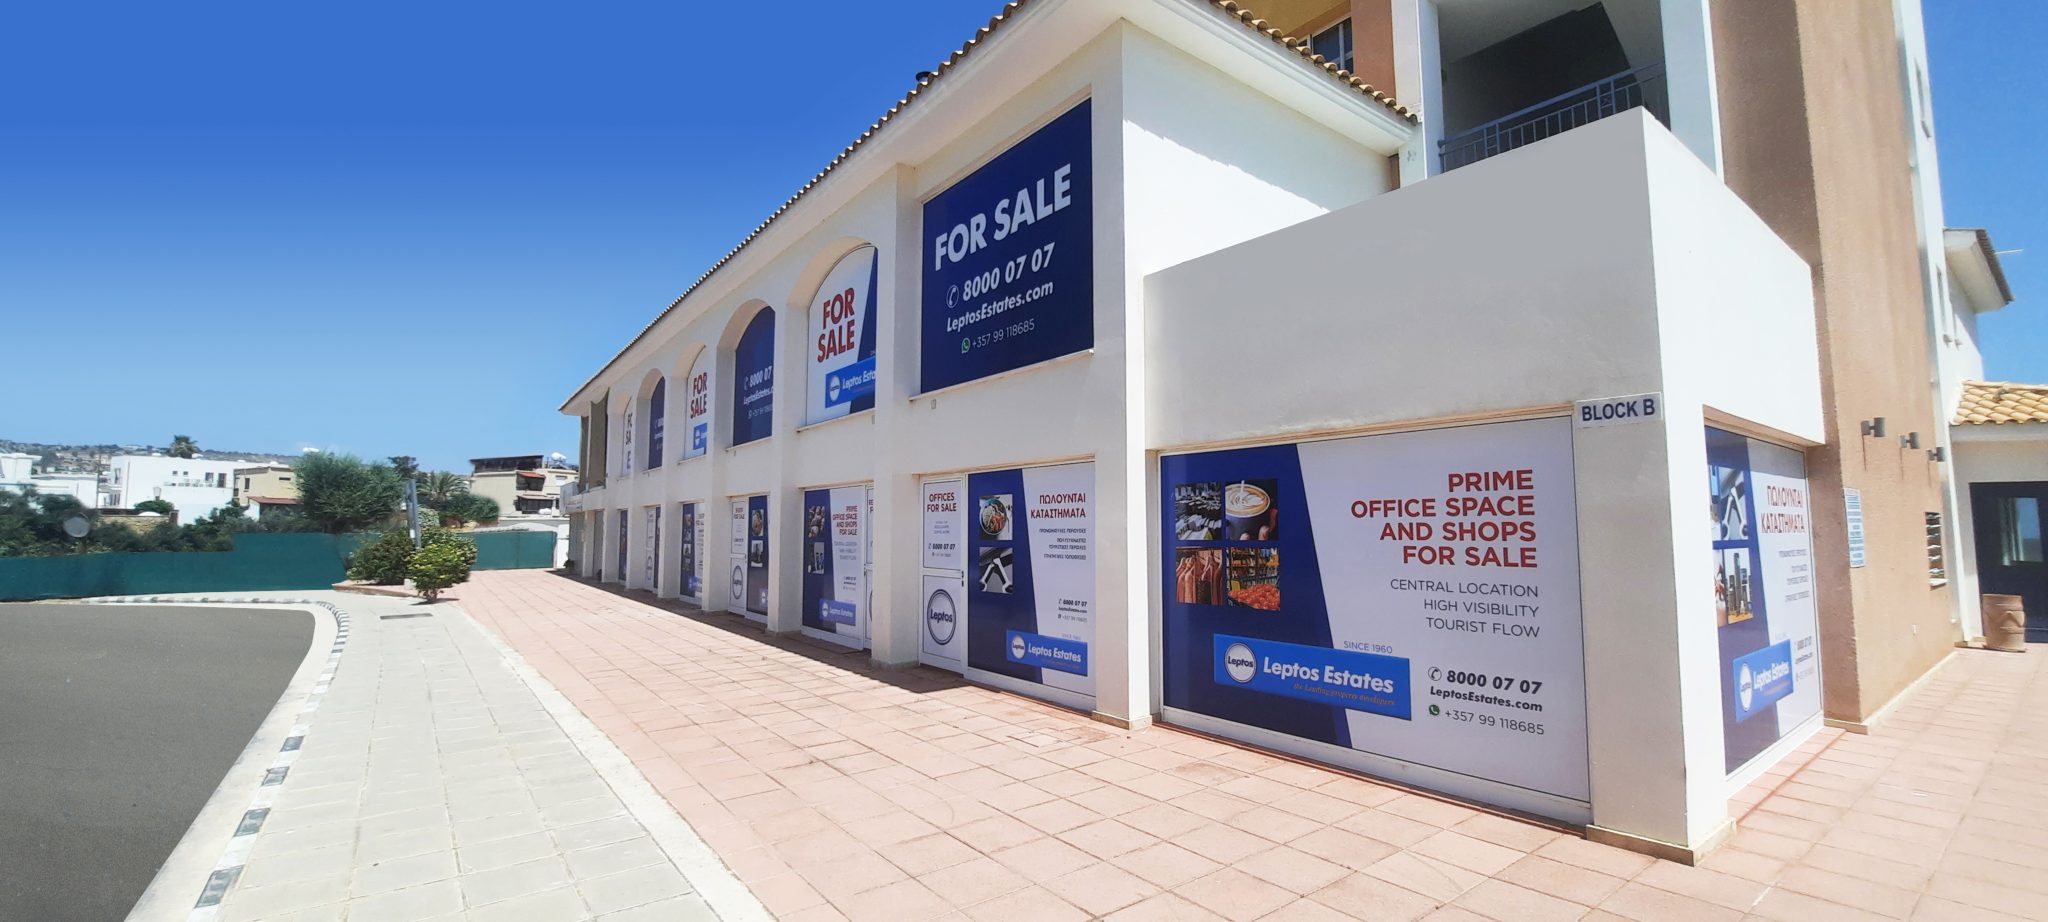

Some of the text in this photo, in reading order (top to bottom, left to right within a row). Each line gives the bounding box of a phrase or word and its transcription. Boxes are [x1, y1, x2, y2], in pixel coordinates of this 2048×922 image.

[935, 163, 1071, 271] FOR SALE
[962, 242, 1055, 302] 8000 07 07
[823, 287, 855, 330] FOR
[946, 280, 1054, 332] LeptosEstates.com
[817, 319, 855, 363] SALE
[971, 318, 1035, 349] +357 99 118685
[693, 372, 707, 396] FOR
[750, 365, 772, 387] 8000 07
[842, 376, 862, 390] Leptos
[690, 393, 707, 419] SALE
[1581, 398, 1655, 421] BLOCK B
[1448, 470, 1534, 492] PRIME
[927, 502, 957, 512] FOR SALE
[929, 492, 955, 502] OFFICES
[1040, 493, 1086, 504] ΠΩΛΟΥΝΤΑΙ
[1351, 495, 1535, 518] OFFICE SPACE
[1767, 485, 1803, 508] ΠΩΛΟΥΝΤΑΙ
[1031, 508, 1086, 518] ΚΑΤΑΣΤΗΜΑΤΑ
[1761, 512, 1805, 534] ΚΑΤΑΣΤΗΜΑΤΑ
[1380, 521, 1537, 542] AND SHOPS
[1403, 546, 1538, 568] FOR SALE
[1390, 579, 1538, 597] CENTRAL LOCATION
[930, 609, 953, 623] Leptos
[1424, 599, 1539, 617] HIGH VISIBILITY
[1426, 617, 1540, 638] TOURIST FLOW
[1028, 643, 1082, 663] Leptos Estates
[1343, 640, 1393, 654] SINCE 1960
[1227, 655, 1254, 668] Leptos
[1263, 656, 1394, 694] Leptos Estates
[1447, 670, 1542, 694] 8000 07 07
[1430, 685, 1542, 712] LeptosEstates.com
[1445, 709, 1545, 735] +357 99 118685
